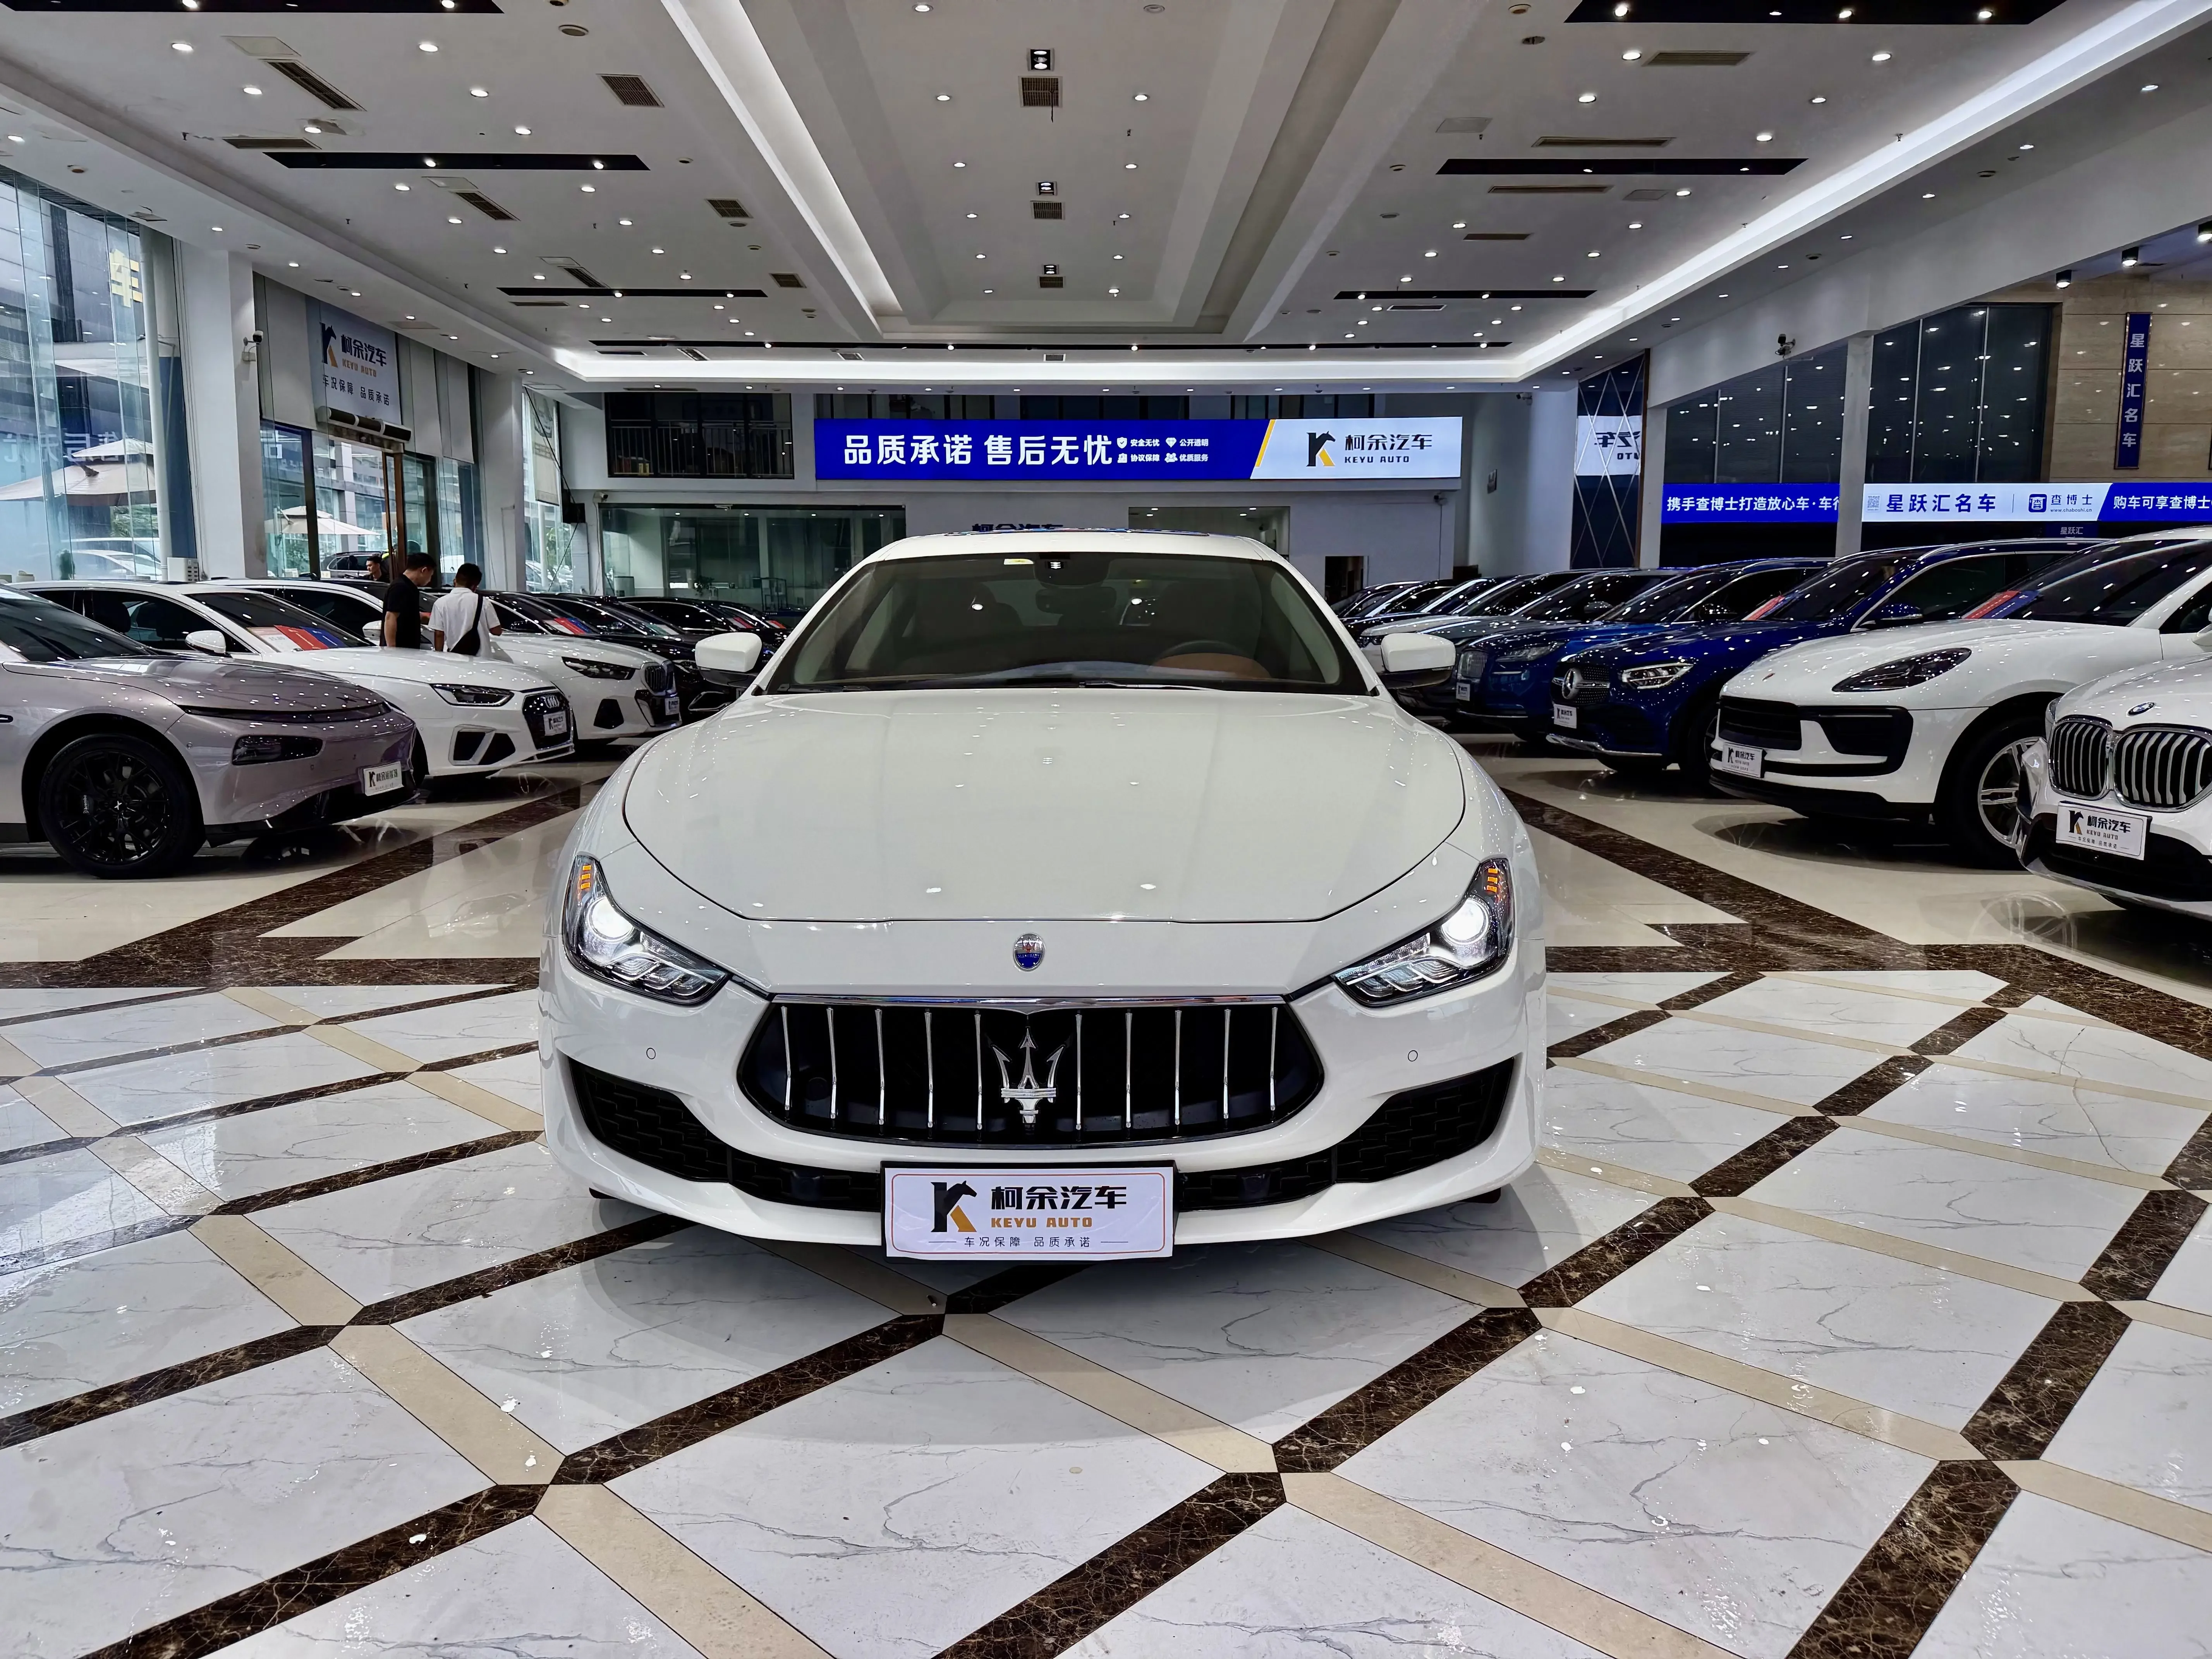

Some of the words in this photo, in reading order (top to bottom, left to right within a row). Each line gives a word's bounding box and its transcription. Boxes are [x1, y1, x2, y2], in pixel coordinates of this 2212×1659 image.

[341, 334, 386, 367] 柯余汽车
[342, 358, 358, 371] KEYU
[361, 365, 377, 378] AUTO
[322, 374, 354, 395] 车况保障
[360, 386, 390, 406] 品质承诺
[2122, 333, 2145, 447] 星跃汇名车
[845, 435, 972, 465] 品质承诺
[984, 434, 1113, 465] 售后无忧
[1130, 438, 1160, 447] 安全无忧
[1179, 438, 1209, 447] 公开透明
[1345, 434, 1432, 451] 柯余汽车
[1130, 454, 1160, 462] 协议保障
[1179, 454, 1209, 462] 优质服务
[1886, 493, 1996, 513] 星跃汇名车
[2051, 494, 2093, 505] 查博士
[2113, 495, 2212, 510] 购车可享查博士
[2087, 815, 2131, 833] 柯余汽车
[991, 1185, 1127, 1210] 柯余汽车
[991, 1218, 1037, 1228] KEYU
[1046, 1217, 1093, 1228] AUTO
[964, 1236, 1021, 1248] 车况保障
[1034, 1236, 1091, 1248] 品质承诺
